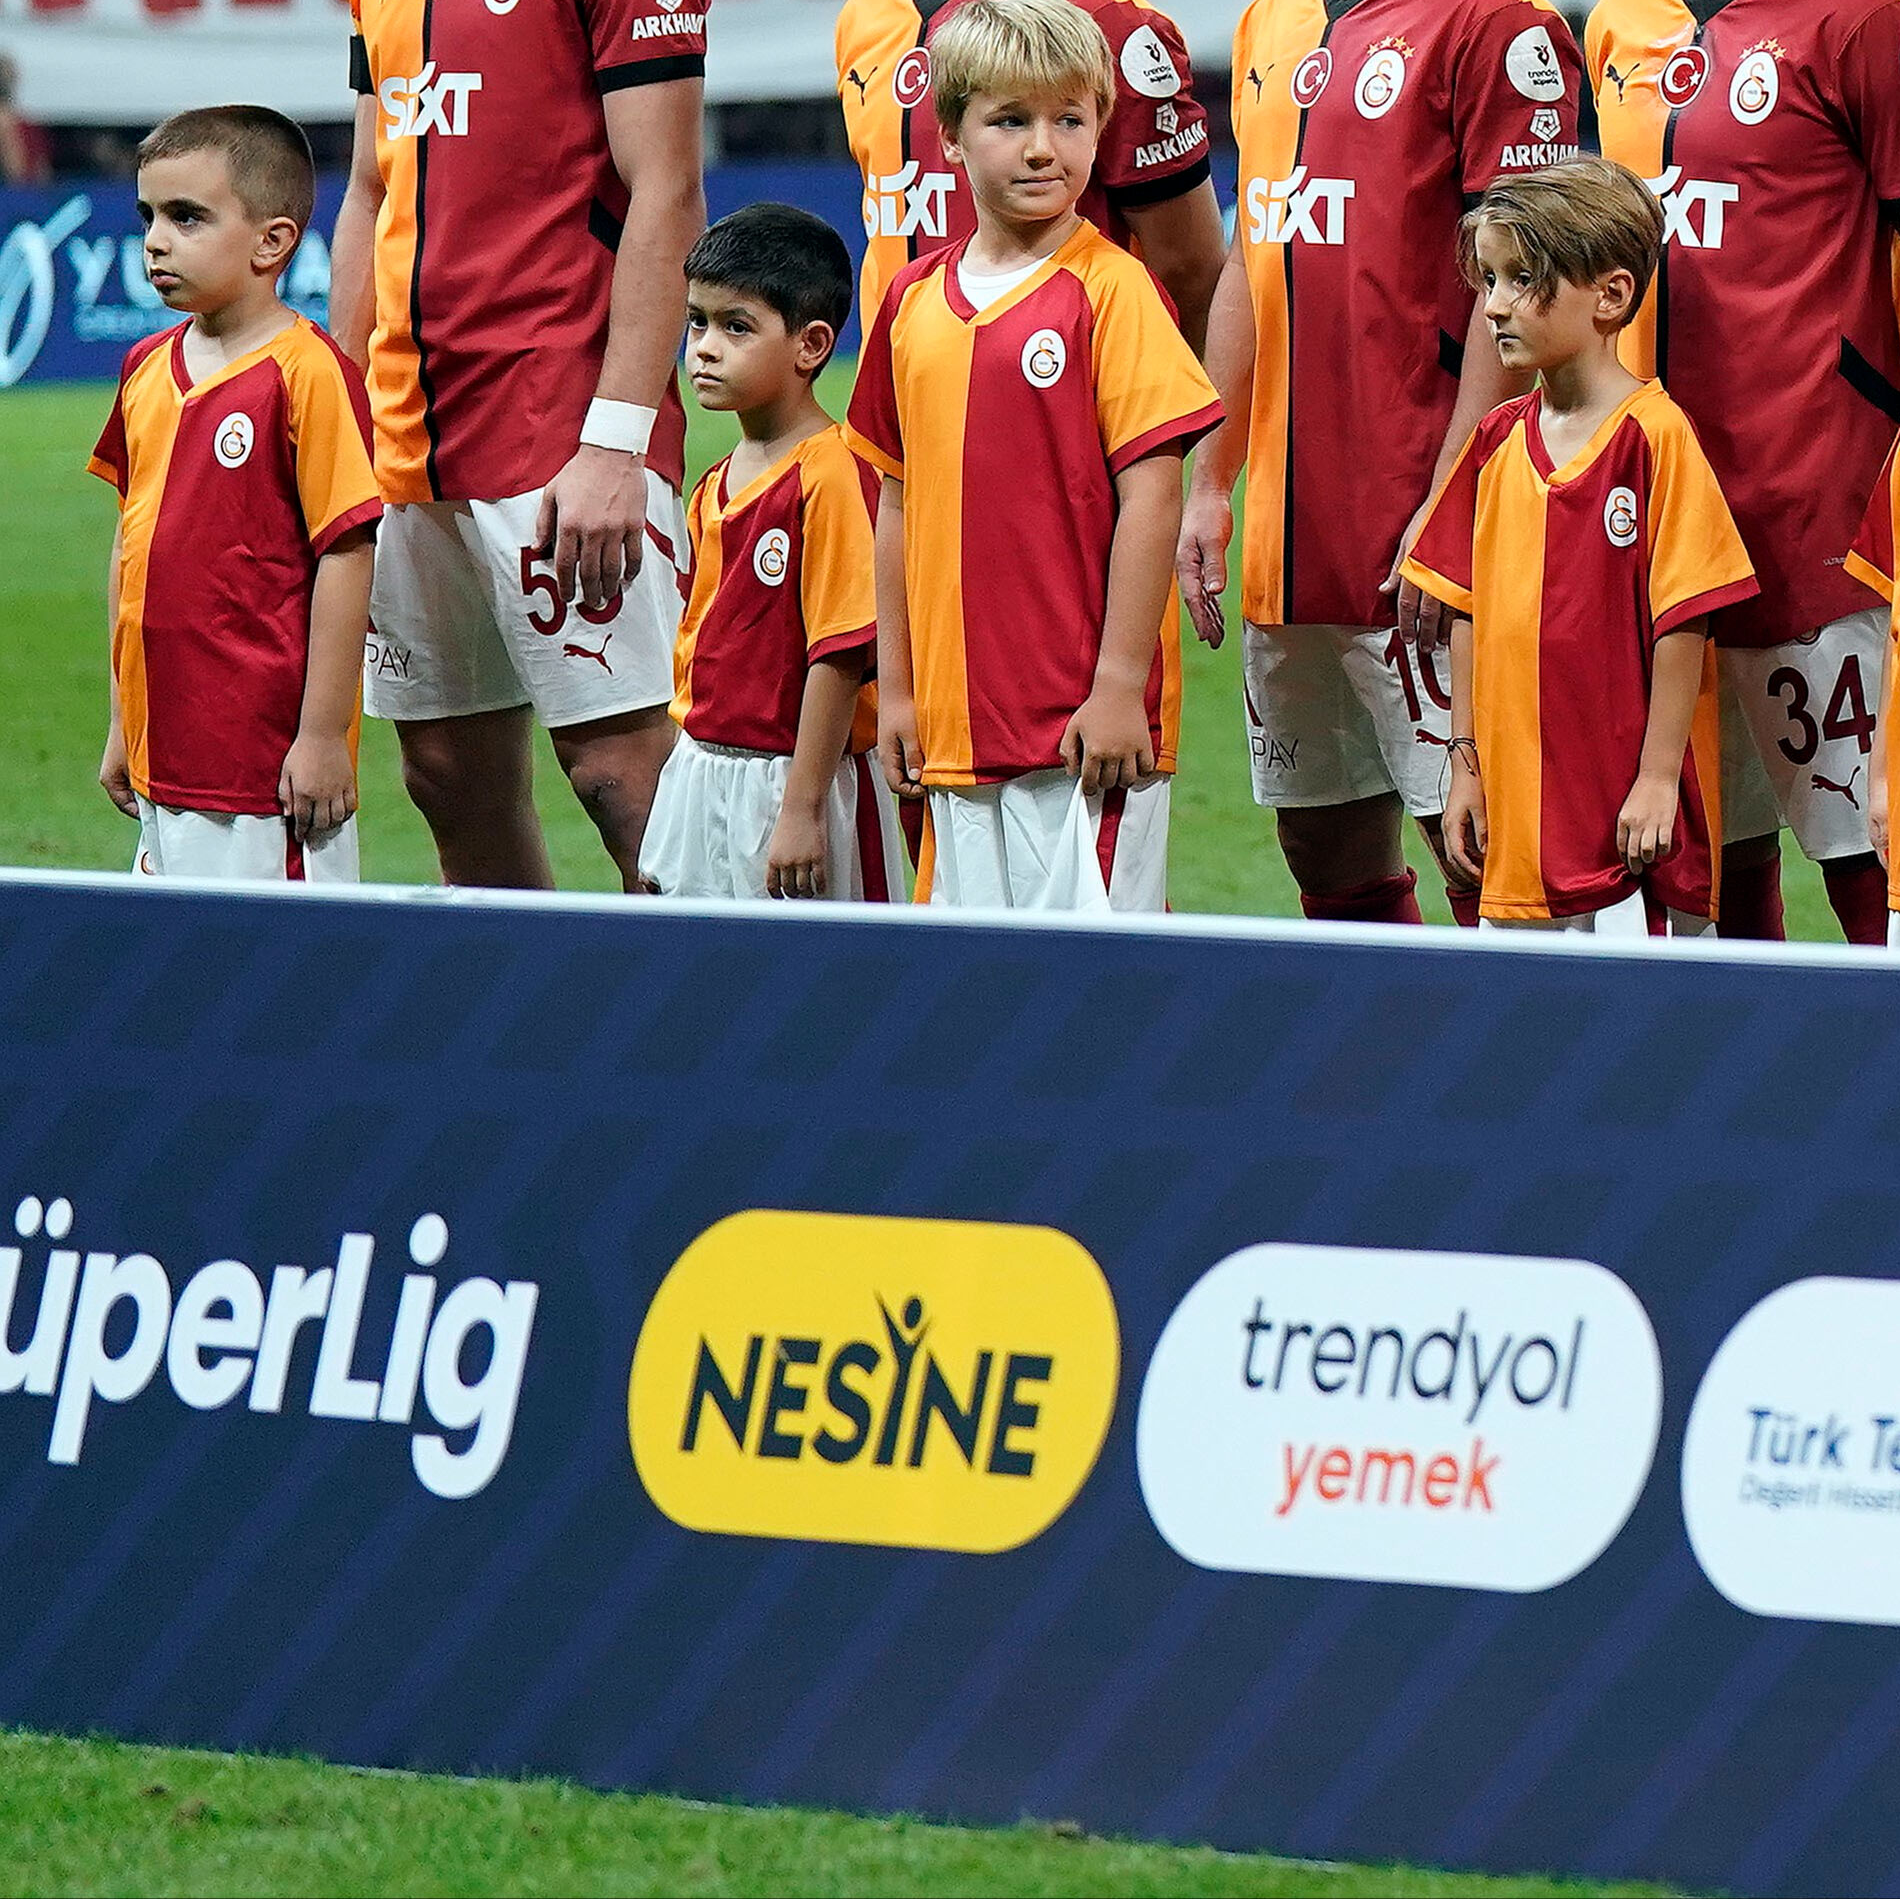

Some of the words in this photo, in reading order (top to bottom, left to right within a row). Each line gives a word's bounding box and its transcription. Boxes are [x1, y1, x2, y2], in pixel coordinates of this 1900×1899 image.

[1767, 653, 1877, 766] 34
[1240, 1297, 1588, 1426] trendyol
[1275, 1437, 1503, 1518] yemek
[1747, 1406, 1851, 1468] Türk
